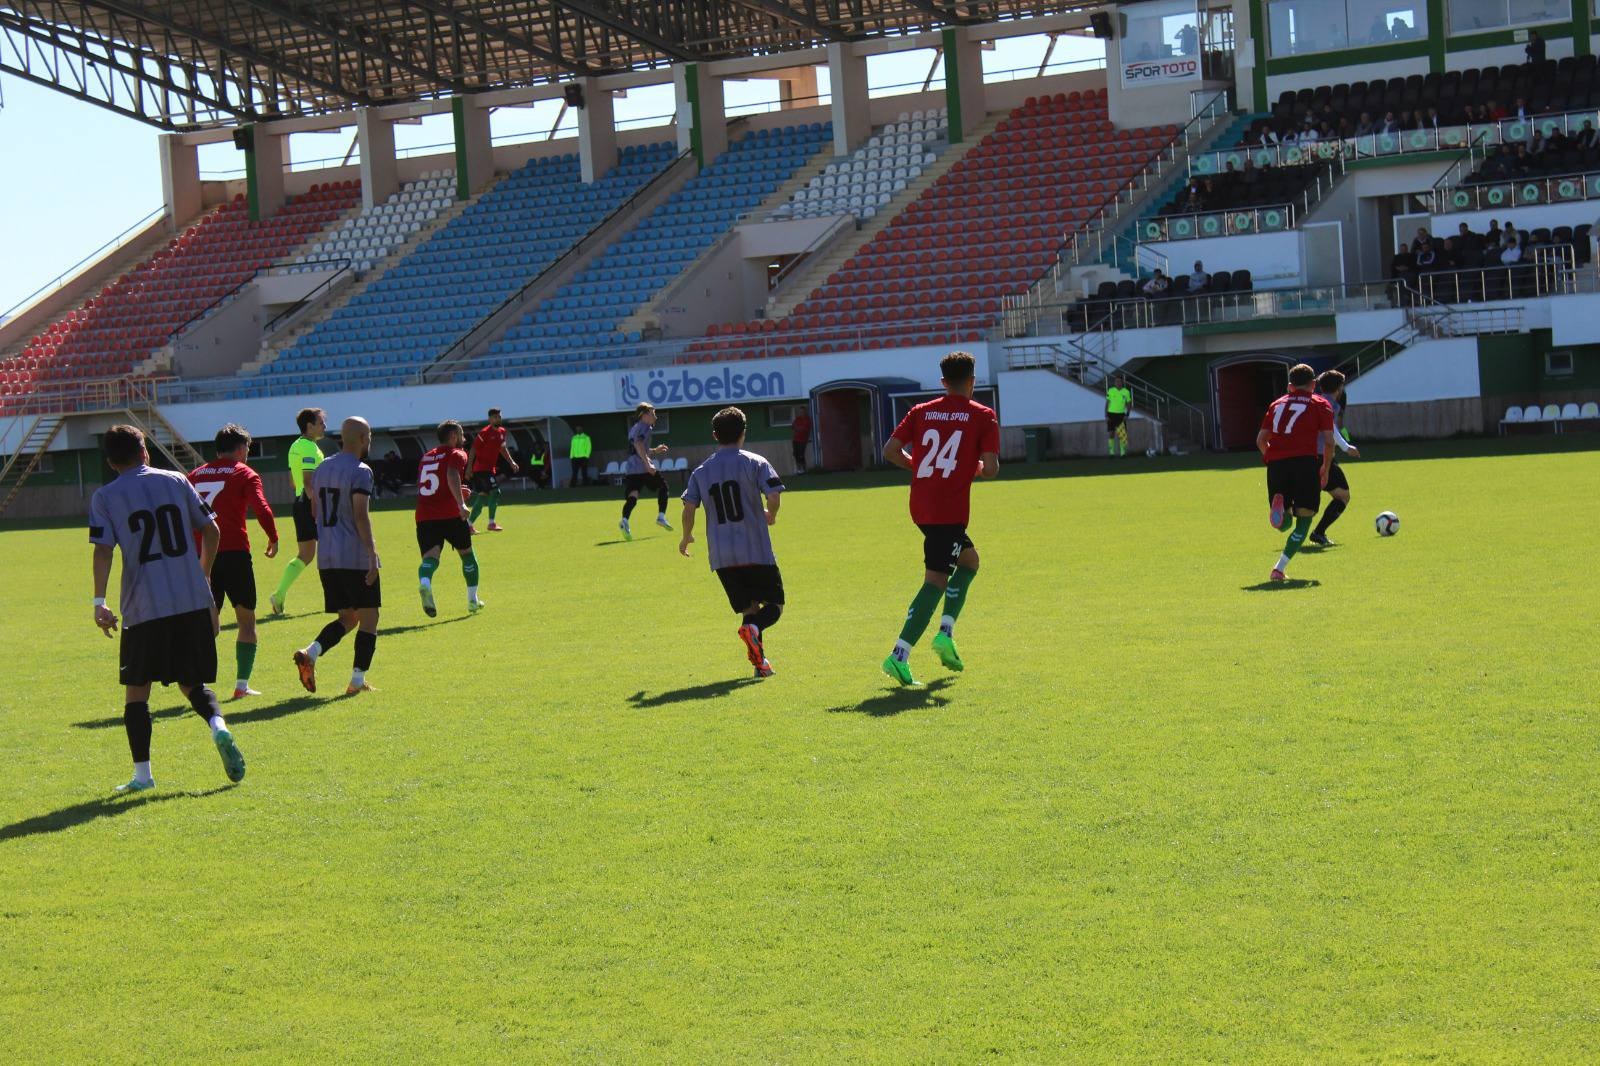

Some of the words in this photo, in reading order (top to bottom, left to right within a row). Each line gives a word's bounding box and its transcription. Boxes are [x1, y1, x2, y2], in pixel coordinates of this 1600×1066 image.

[647, 367, 785, 404] özbelsan
[950, 412, 970, 422] SPOR
[1272, 402, 1307, 434] 17
[916, 428, 963, 479] 24
[419, 462, 440, 496] 5
[319, 486, 340, 528] 17
[708, 480, 745, 525] 10
[128, 503, 188, 565] 20
